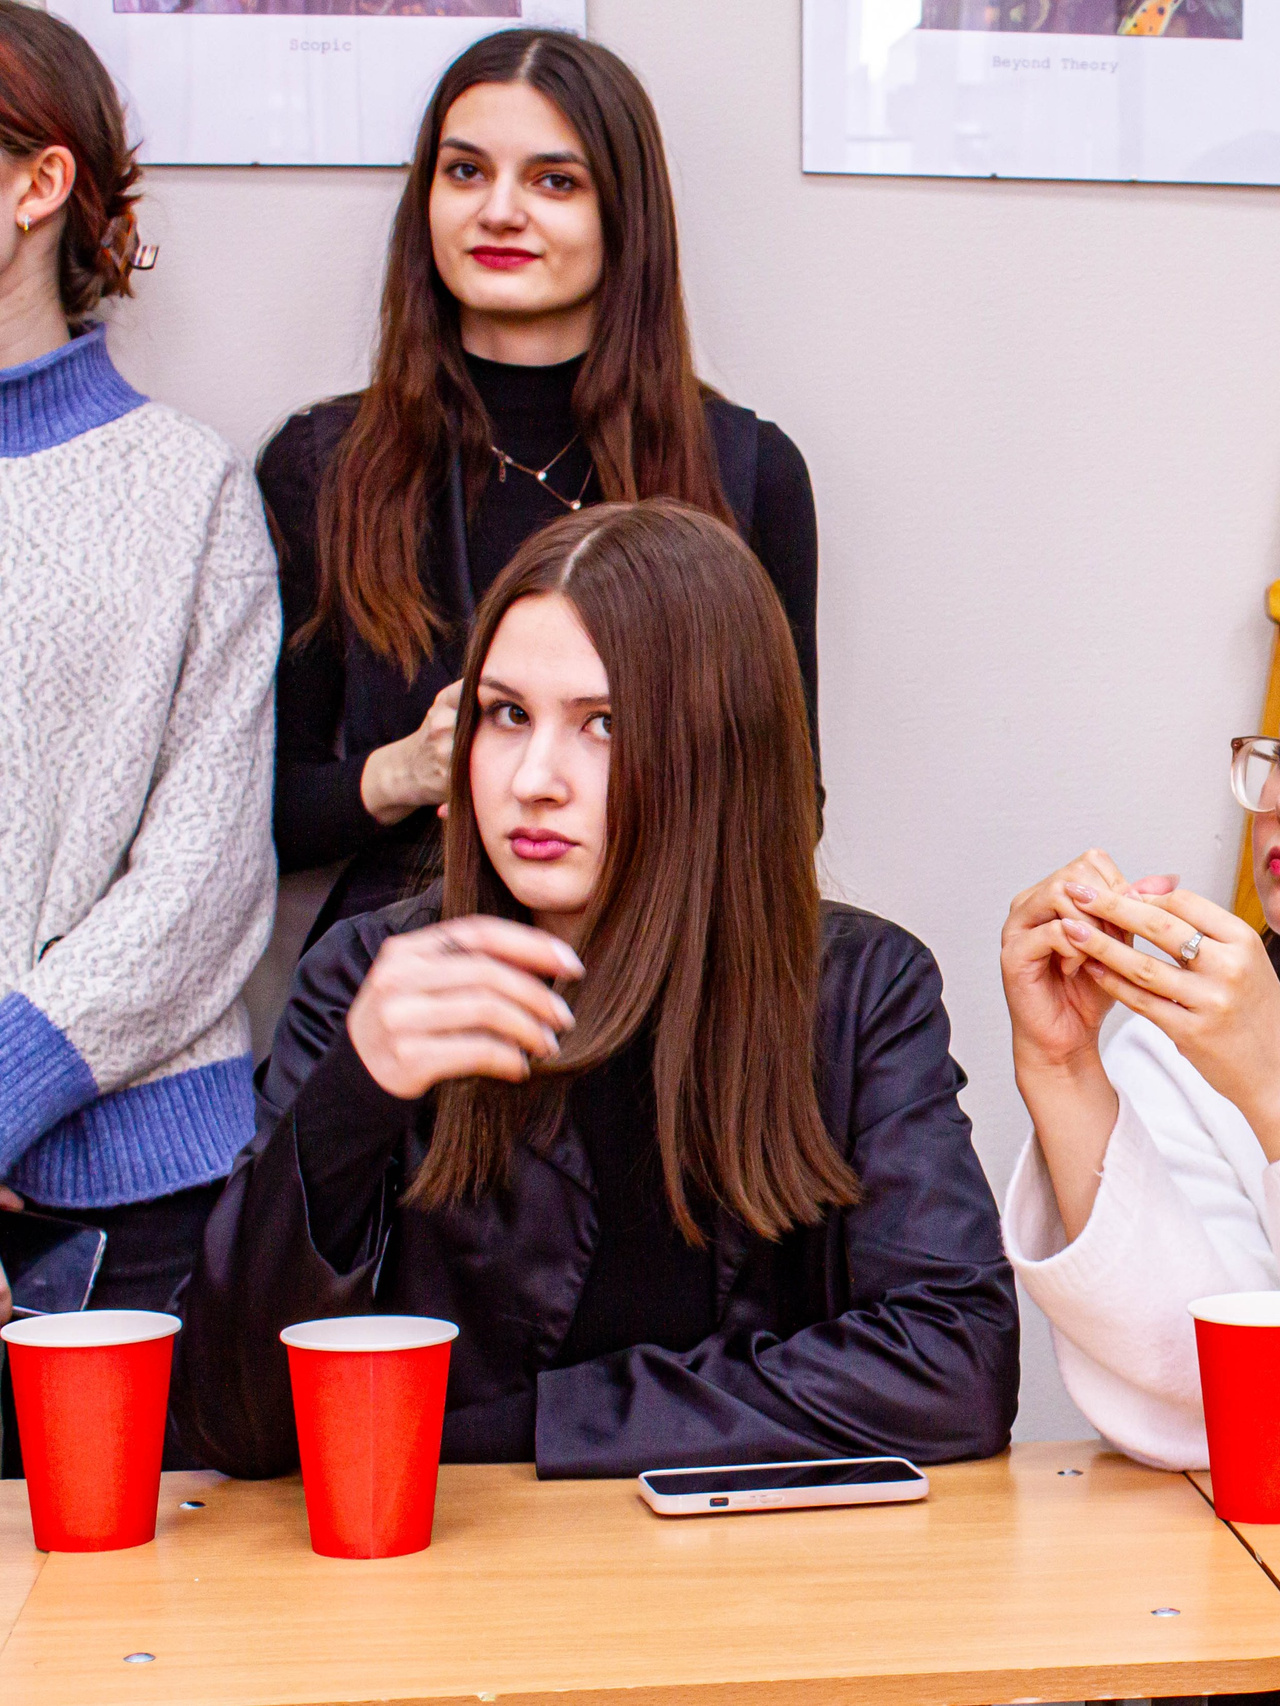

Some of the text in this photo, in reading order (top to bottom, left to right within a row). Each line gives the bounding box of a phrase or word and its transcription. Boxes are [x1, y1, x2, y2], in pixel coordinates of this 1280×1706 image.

[289, 38, 352, 54] Scopic
[992, 55, 1119, 74] Beyond Theory
